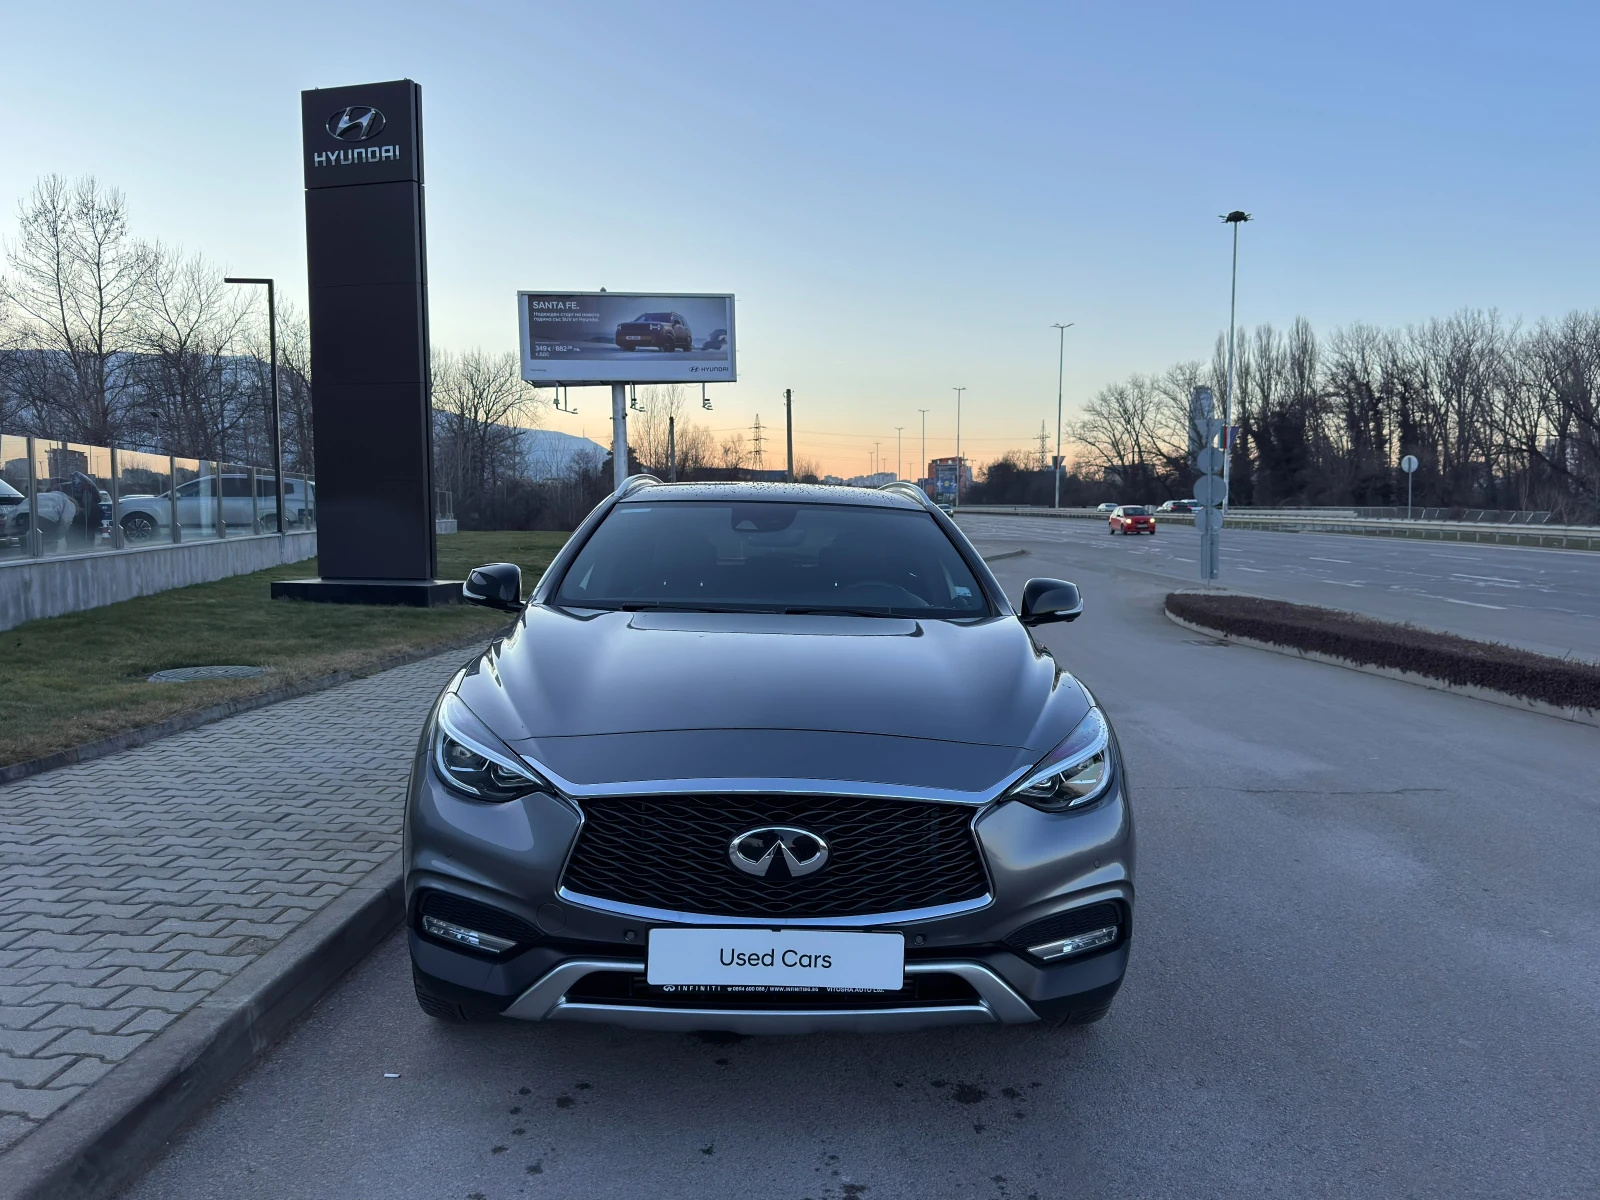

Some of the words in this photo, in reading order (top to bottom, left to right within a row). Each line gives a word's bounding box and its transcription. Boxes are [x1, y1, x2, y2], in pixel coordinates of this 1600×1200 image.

[314, 145, 400, 167] HYUNDAI
[533, 301, 565, 310] SANTA
[566, 301, 580, 310] FE.
[720, 948, 774, 966] Used
[781, 949, 832, 968] Cars
